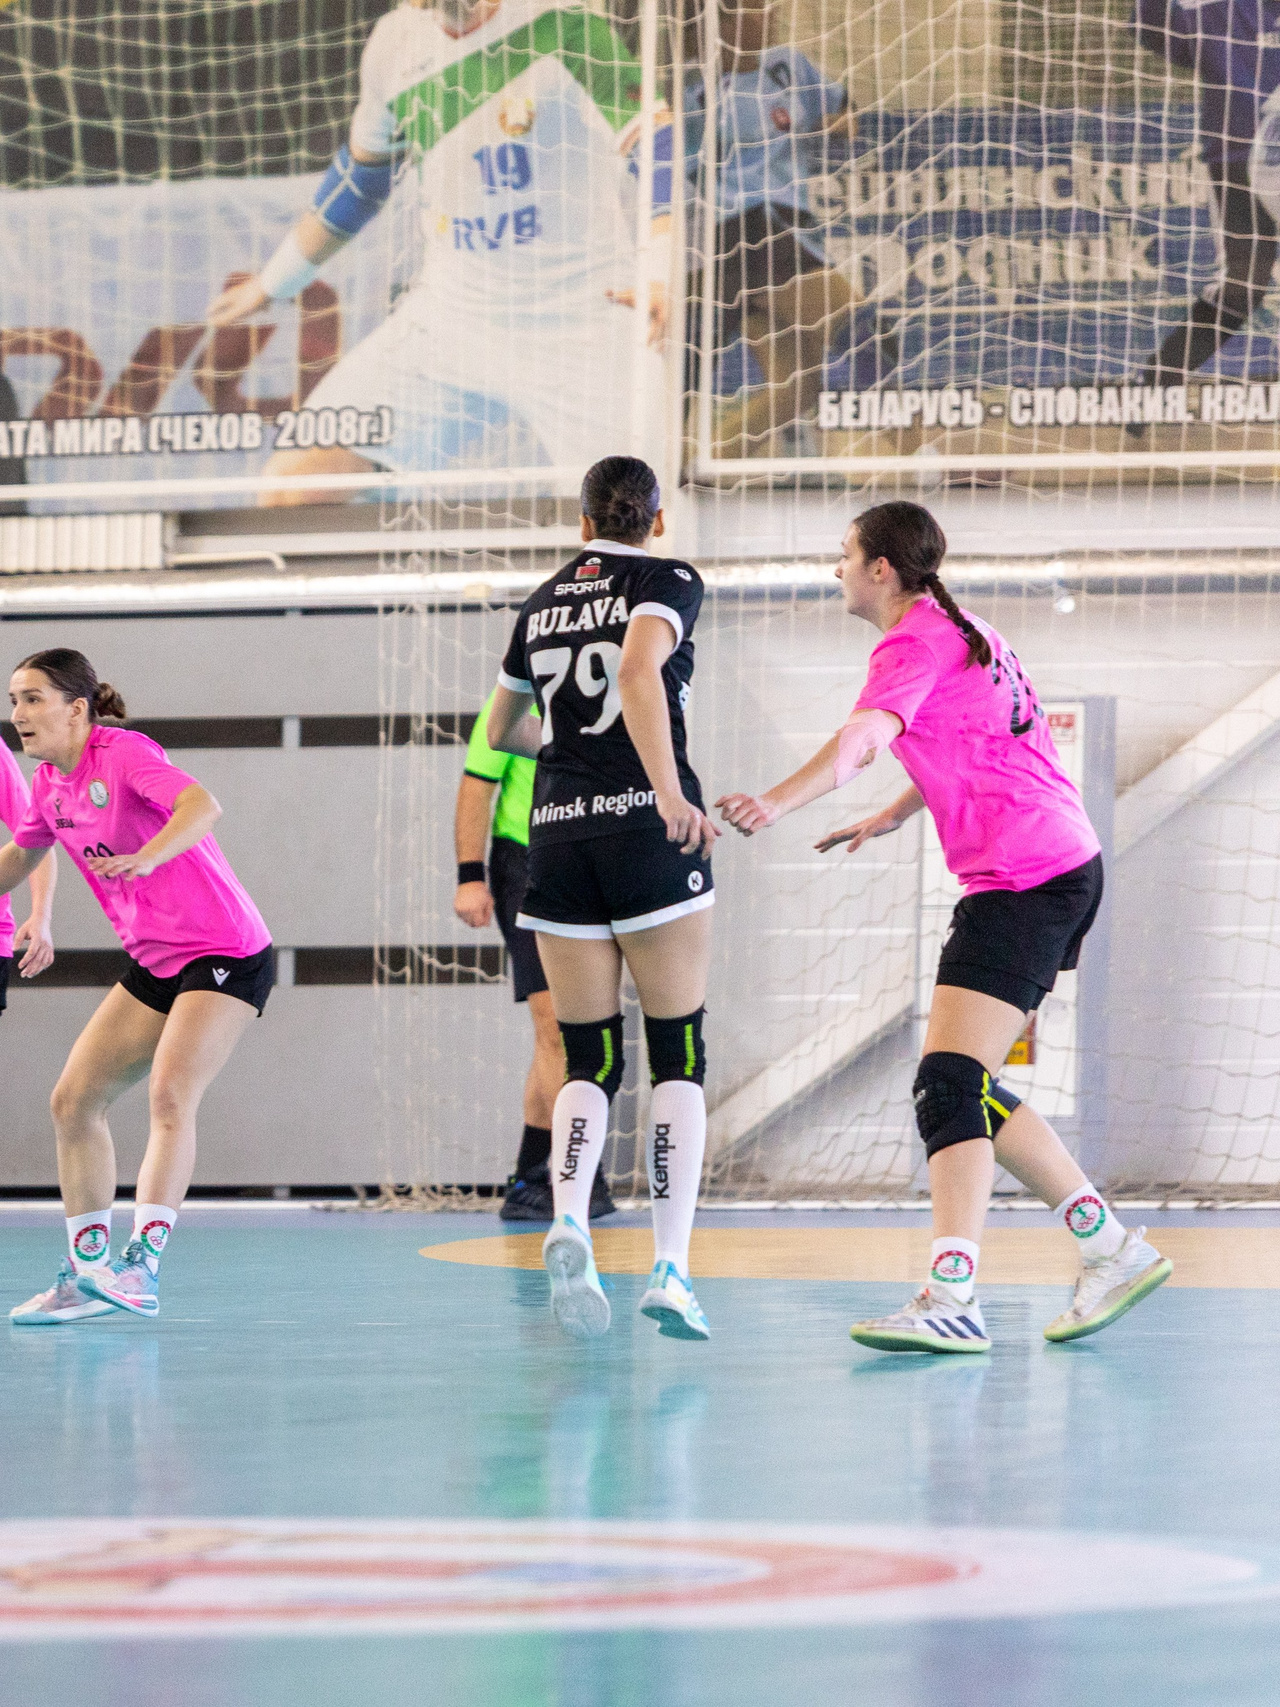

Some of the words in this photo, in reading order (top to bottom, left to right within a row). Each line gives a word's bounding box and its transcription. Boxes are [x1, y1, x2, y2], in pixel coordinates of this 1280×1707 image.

[473, 142, 533, 195] 19
[453, 205, 543, 251] RVB
[819, 389, 985, 428] БЕЛАРУСЬ
[1010, 386, 1195, 425] СЛОВАКИЯ.
[53, 417, 142, 454] МИРА
[148, 412, 262, 450] (ЧЕХОВ
[554, 575, 614, 596] SPORTIX
[526, 596, 631, 643] BULAVA
[530, 641, 623, 746] 79
[531, 796, 587, 827] Minsk
[592, 786, 657, 816] Region
[559, 1117, 589, 1183] Kempa
[653, 1123, 676, 1200] Kempa
